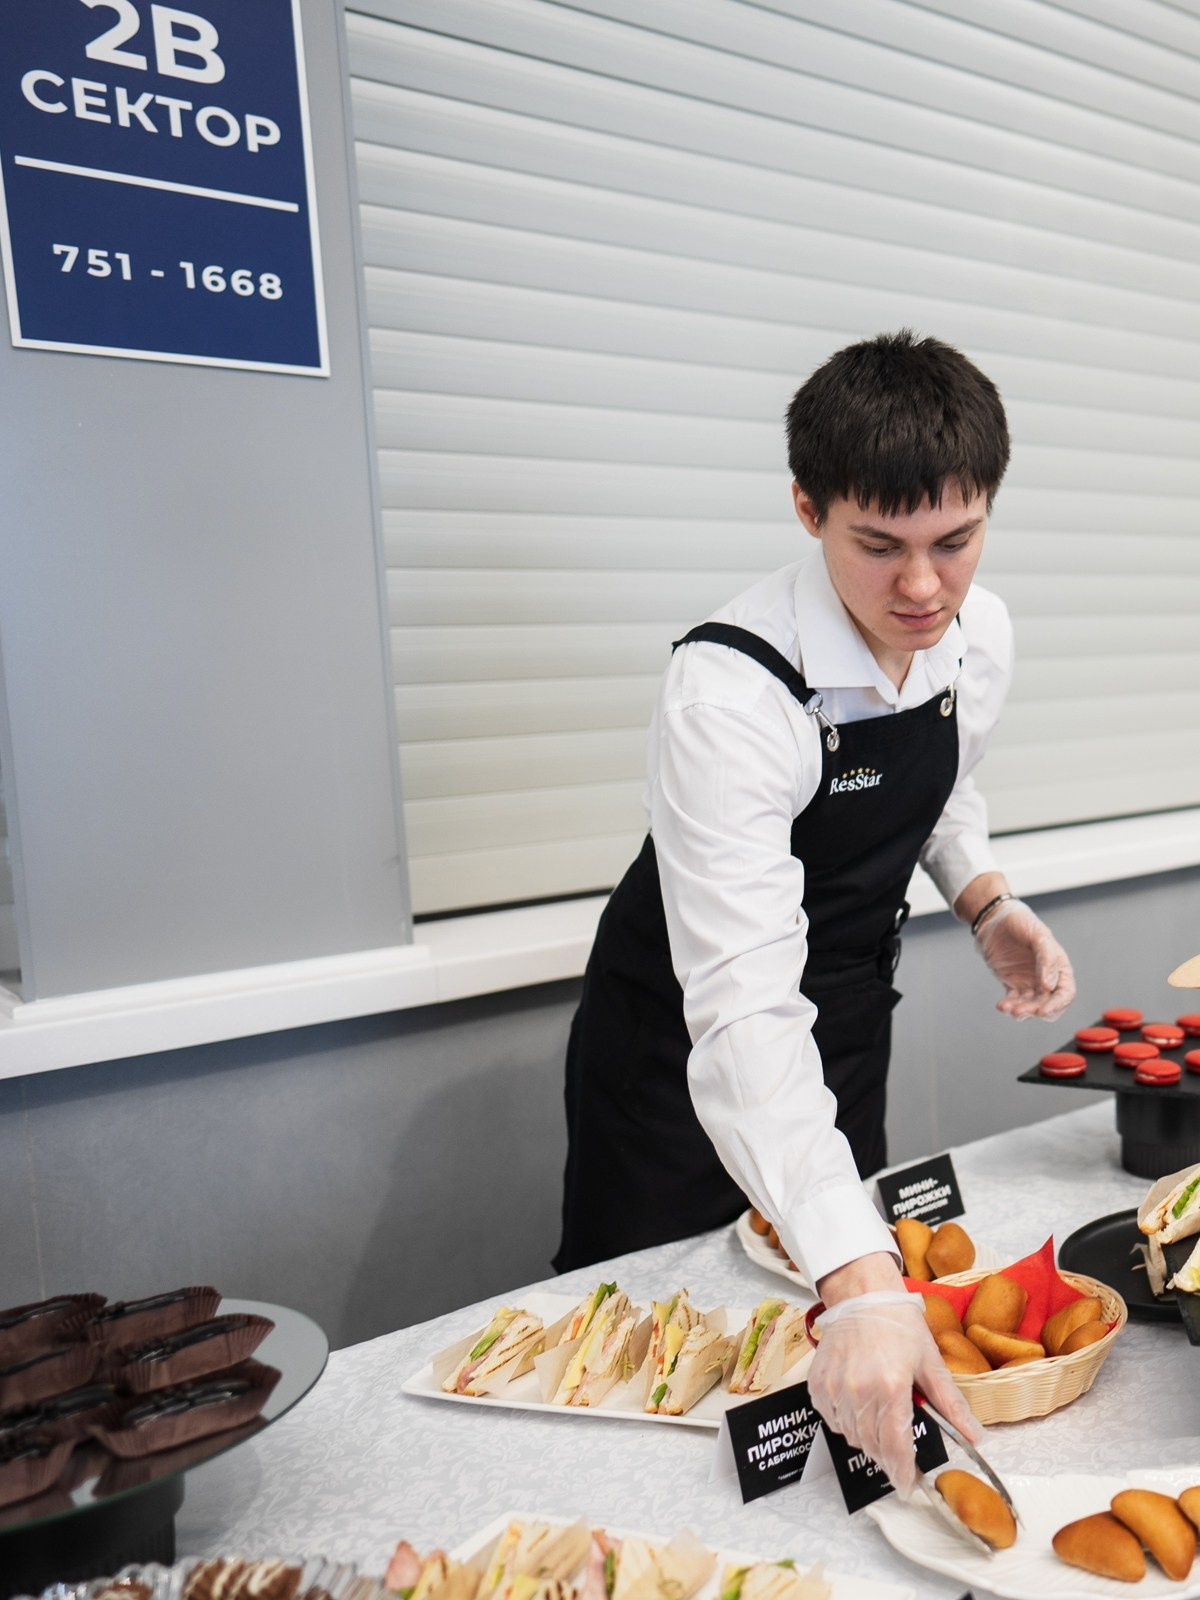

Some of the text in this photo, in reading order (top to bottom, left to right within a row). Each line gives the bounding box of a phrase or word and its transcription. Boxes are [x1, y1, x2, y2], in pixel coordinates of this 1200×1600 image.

[20, 69, 281, 153] СЕКТОР
[52, 243, 284, 300] 751 - 1668
[829, 773, 883, 795] ResStar
[892, 1184, 952, 1216] ПИРОЖКИ
[898, 1177, 938, 1200] МИНИ-
[758, 1407, 814, 1439] МИНИ-
[747, 1420, 822, 1463] ПИРОЖК
[758, 1442, 812, 1471] С АБРИКОС
